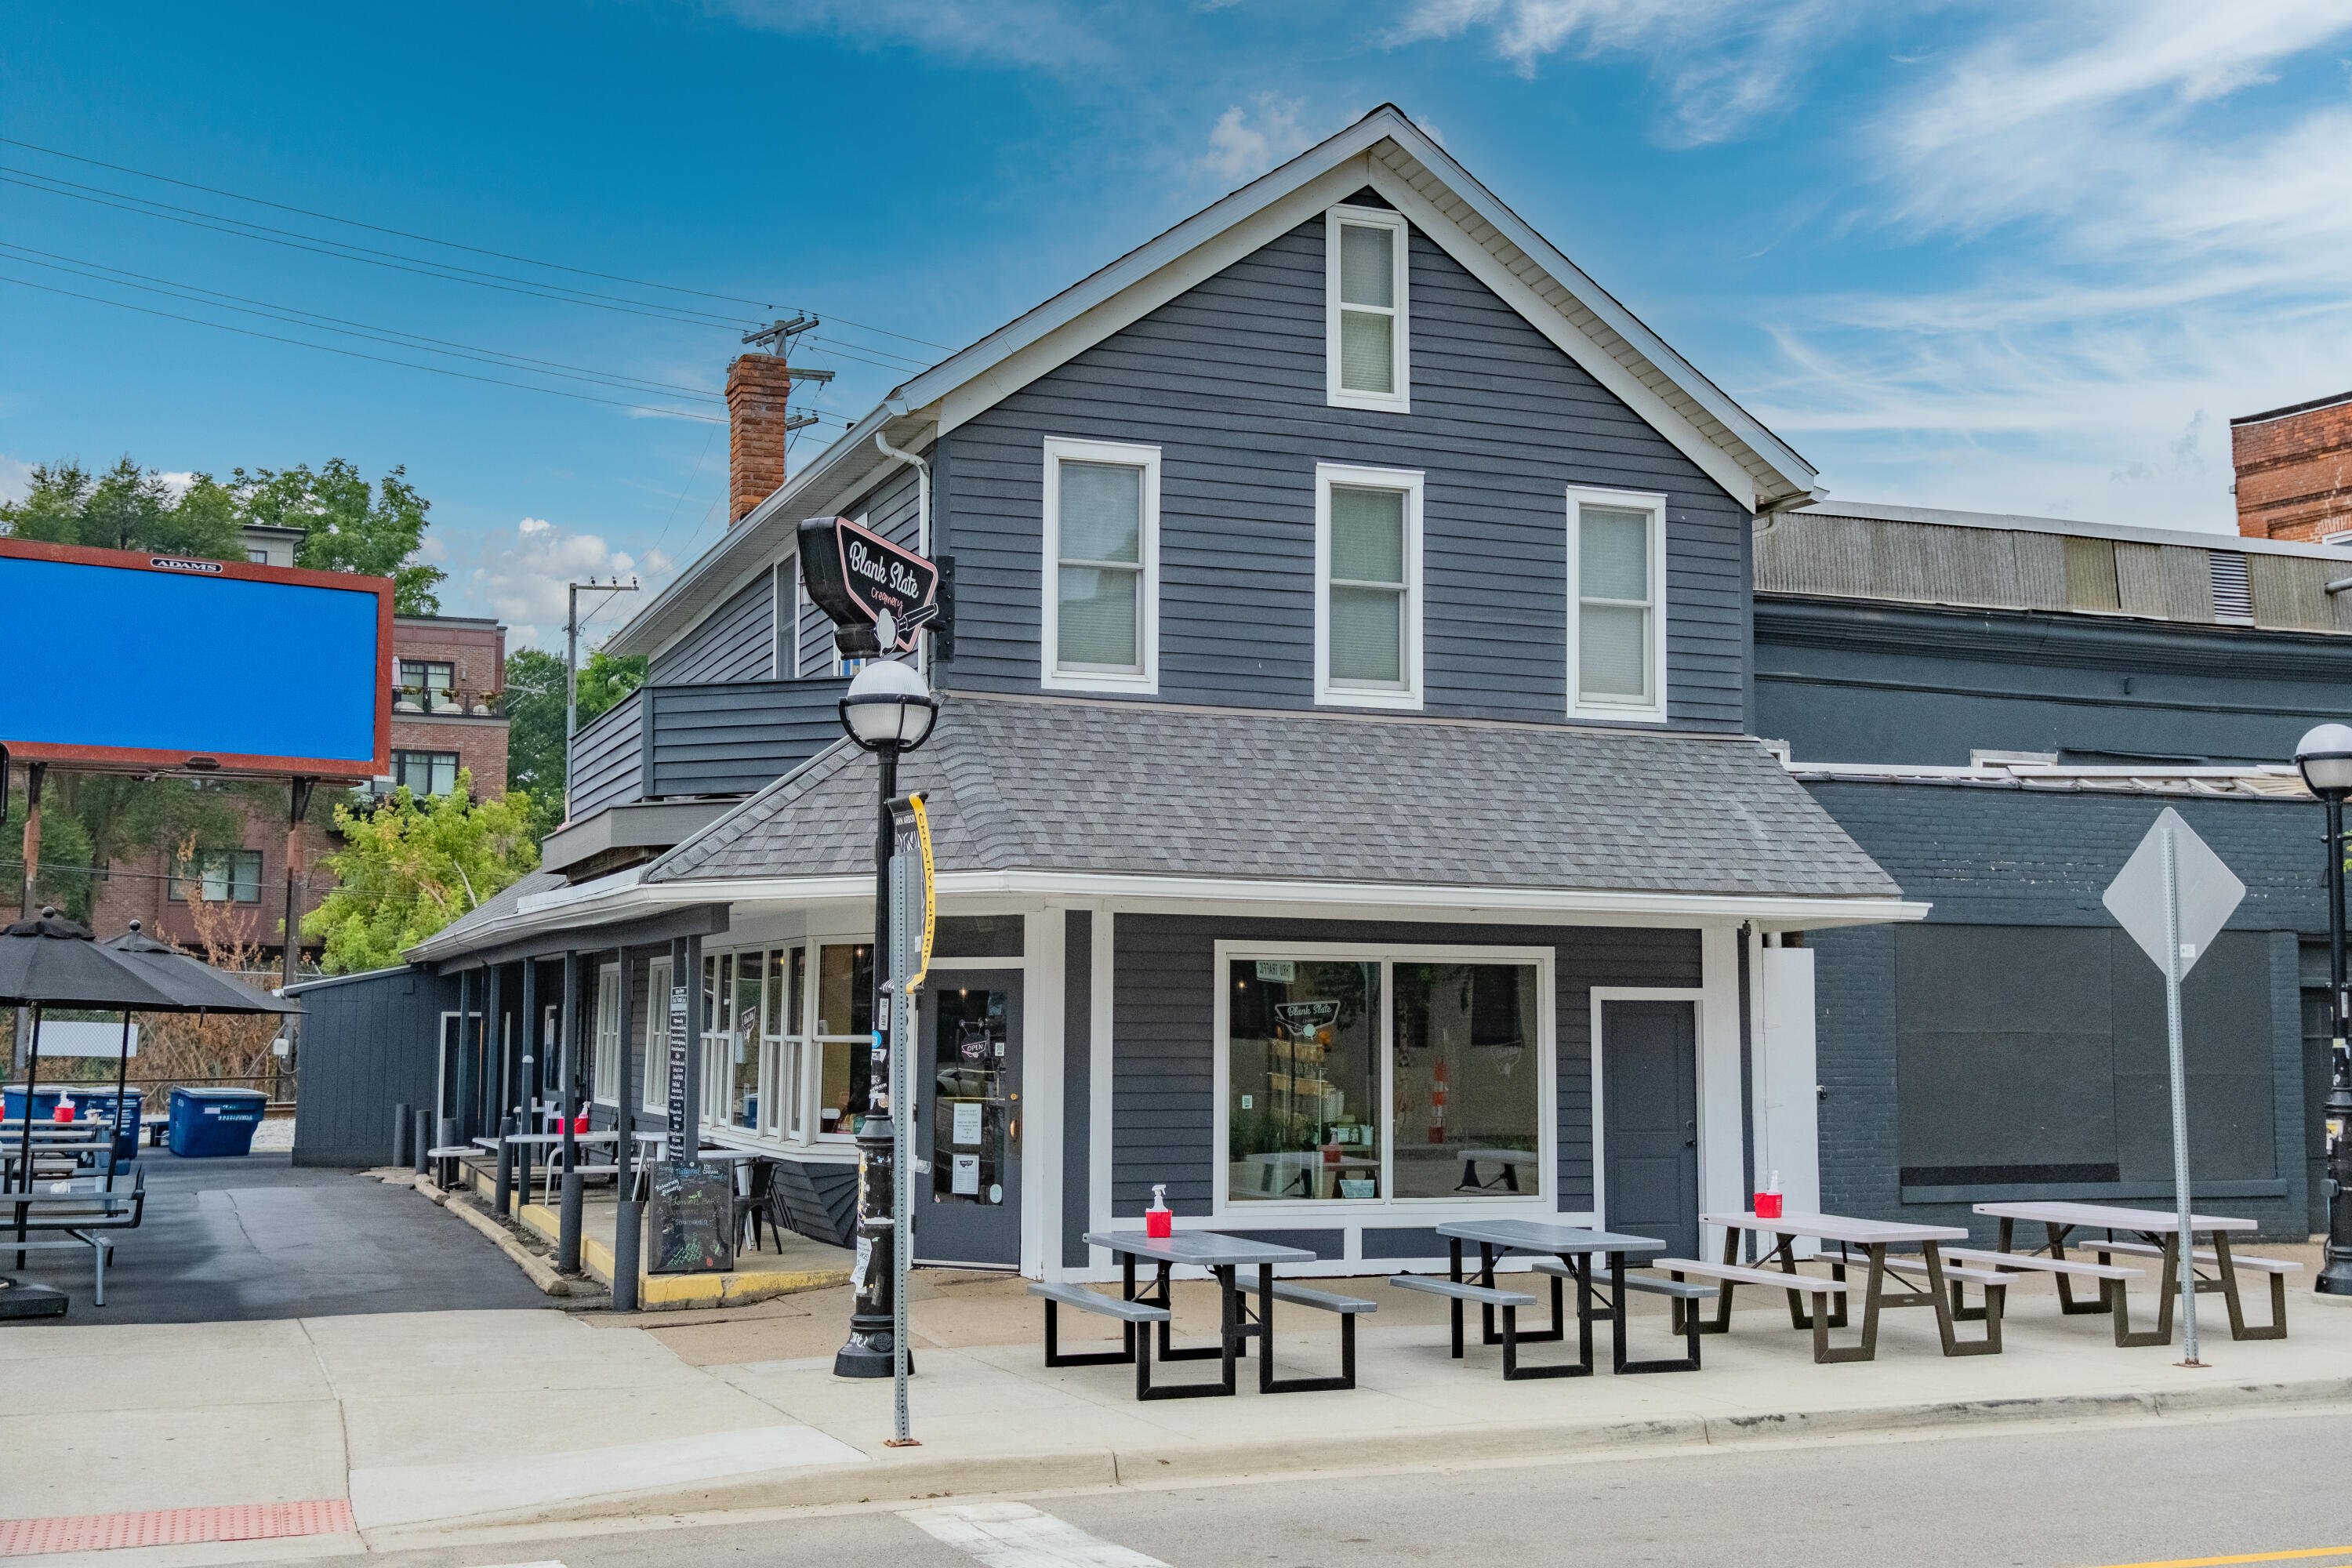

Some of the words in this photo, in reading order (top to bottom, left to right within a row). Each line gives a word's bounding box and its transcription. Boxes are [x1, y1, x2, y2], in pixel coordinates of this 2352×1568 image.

[157, 561, 217, 572] ADAMS
[849, 541, 887, 584] Blank
[890, 561, 919, 599] Slate
[871, 586, 903, 617] Creamery
[903, 814, 916, 824] ARBOR
[918, 812, 932, 894] CREATIVE
[920, 900, 933, 975] DISTRICT
[1287, 1005, 1311, 1017] Blank
[1313, 1004, 1332, 1014] Slate
[967, 1043, 983, 1051] OPEN
